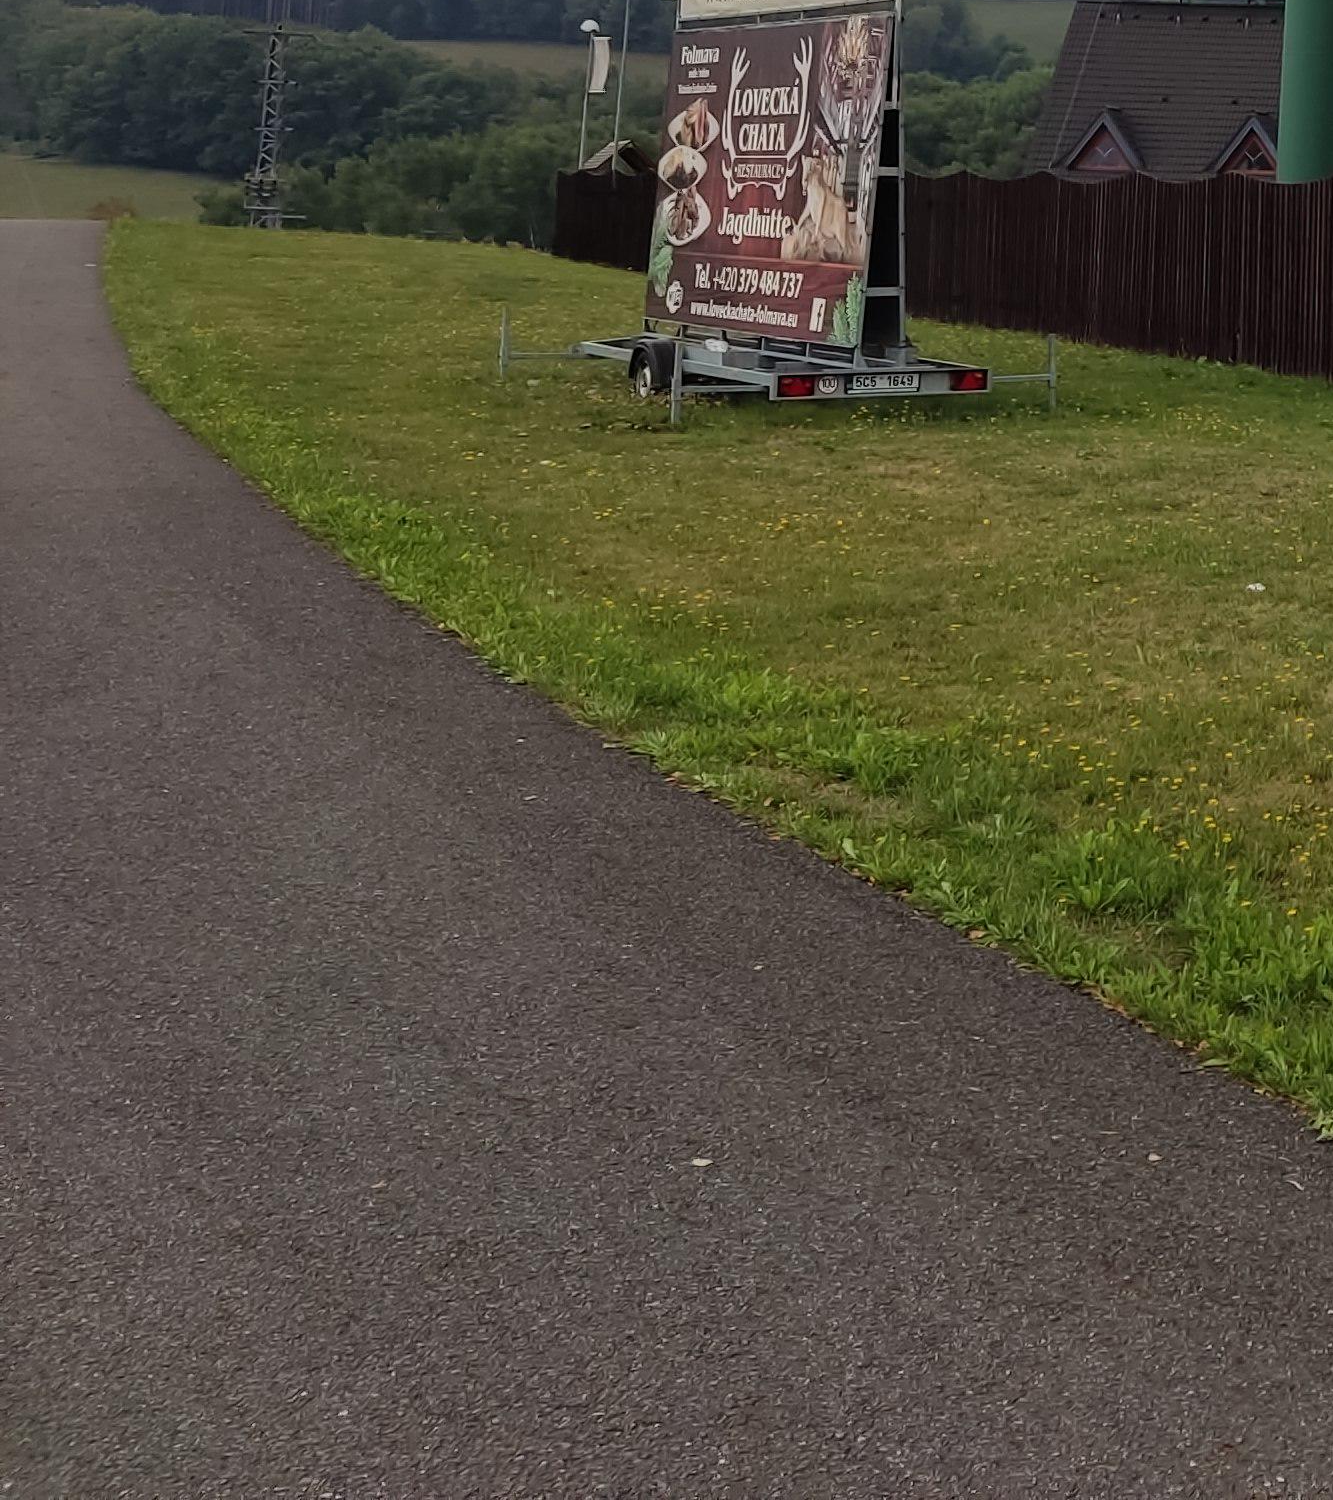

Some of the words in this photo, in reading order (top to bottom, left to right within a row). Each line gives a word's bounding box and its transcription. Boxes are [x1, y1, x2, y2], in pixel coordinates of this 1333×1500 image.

[681, 45, 720, 65] Folmava
[733, 78, 800, 116] LOVECKÁ
[738, 123, 786, 152] CHATA
[717, 206, 793, 245] Jagdhütte
[695, 262, 711, 290] Tel.
[713, 266, 737, 291] +420
[737, 268, 758, 295] 379
[759, 270, 780, 297] 484
[780, 272, 804, 299] 737
[690, 299, 799, 329] www.loveckachata-folmava.eu
[822, 377, 836, 389] 100
[855, 375, 877, 388] 5C5
[887, 374, 914, 387] 1649
